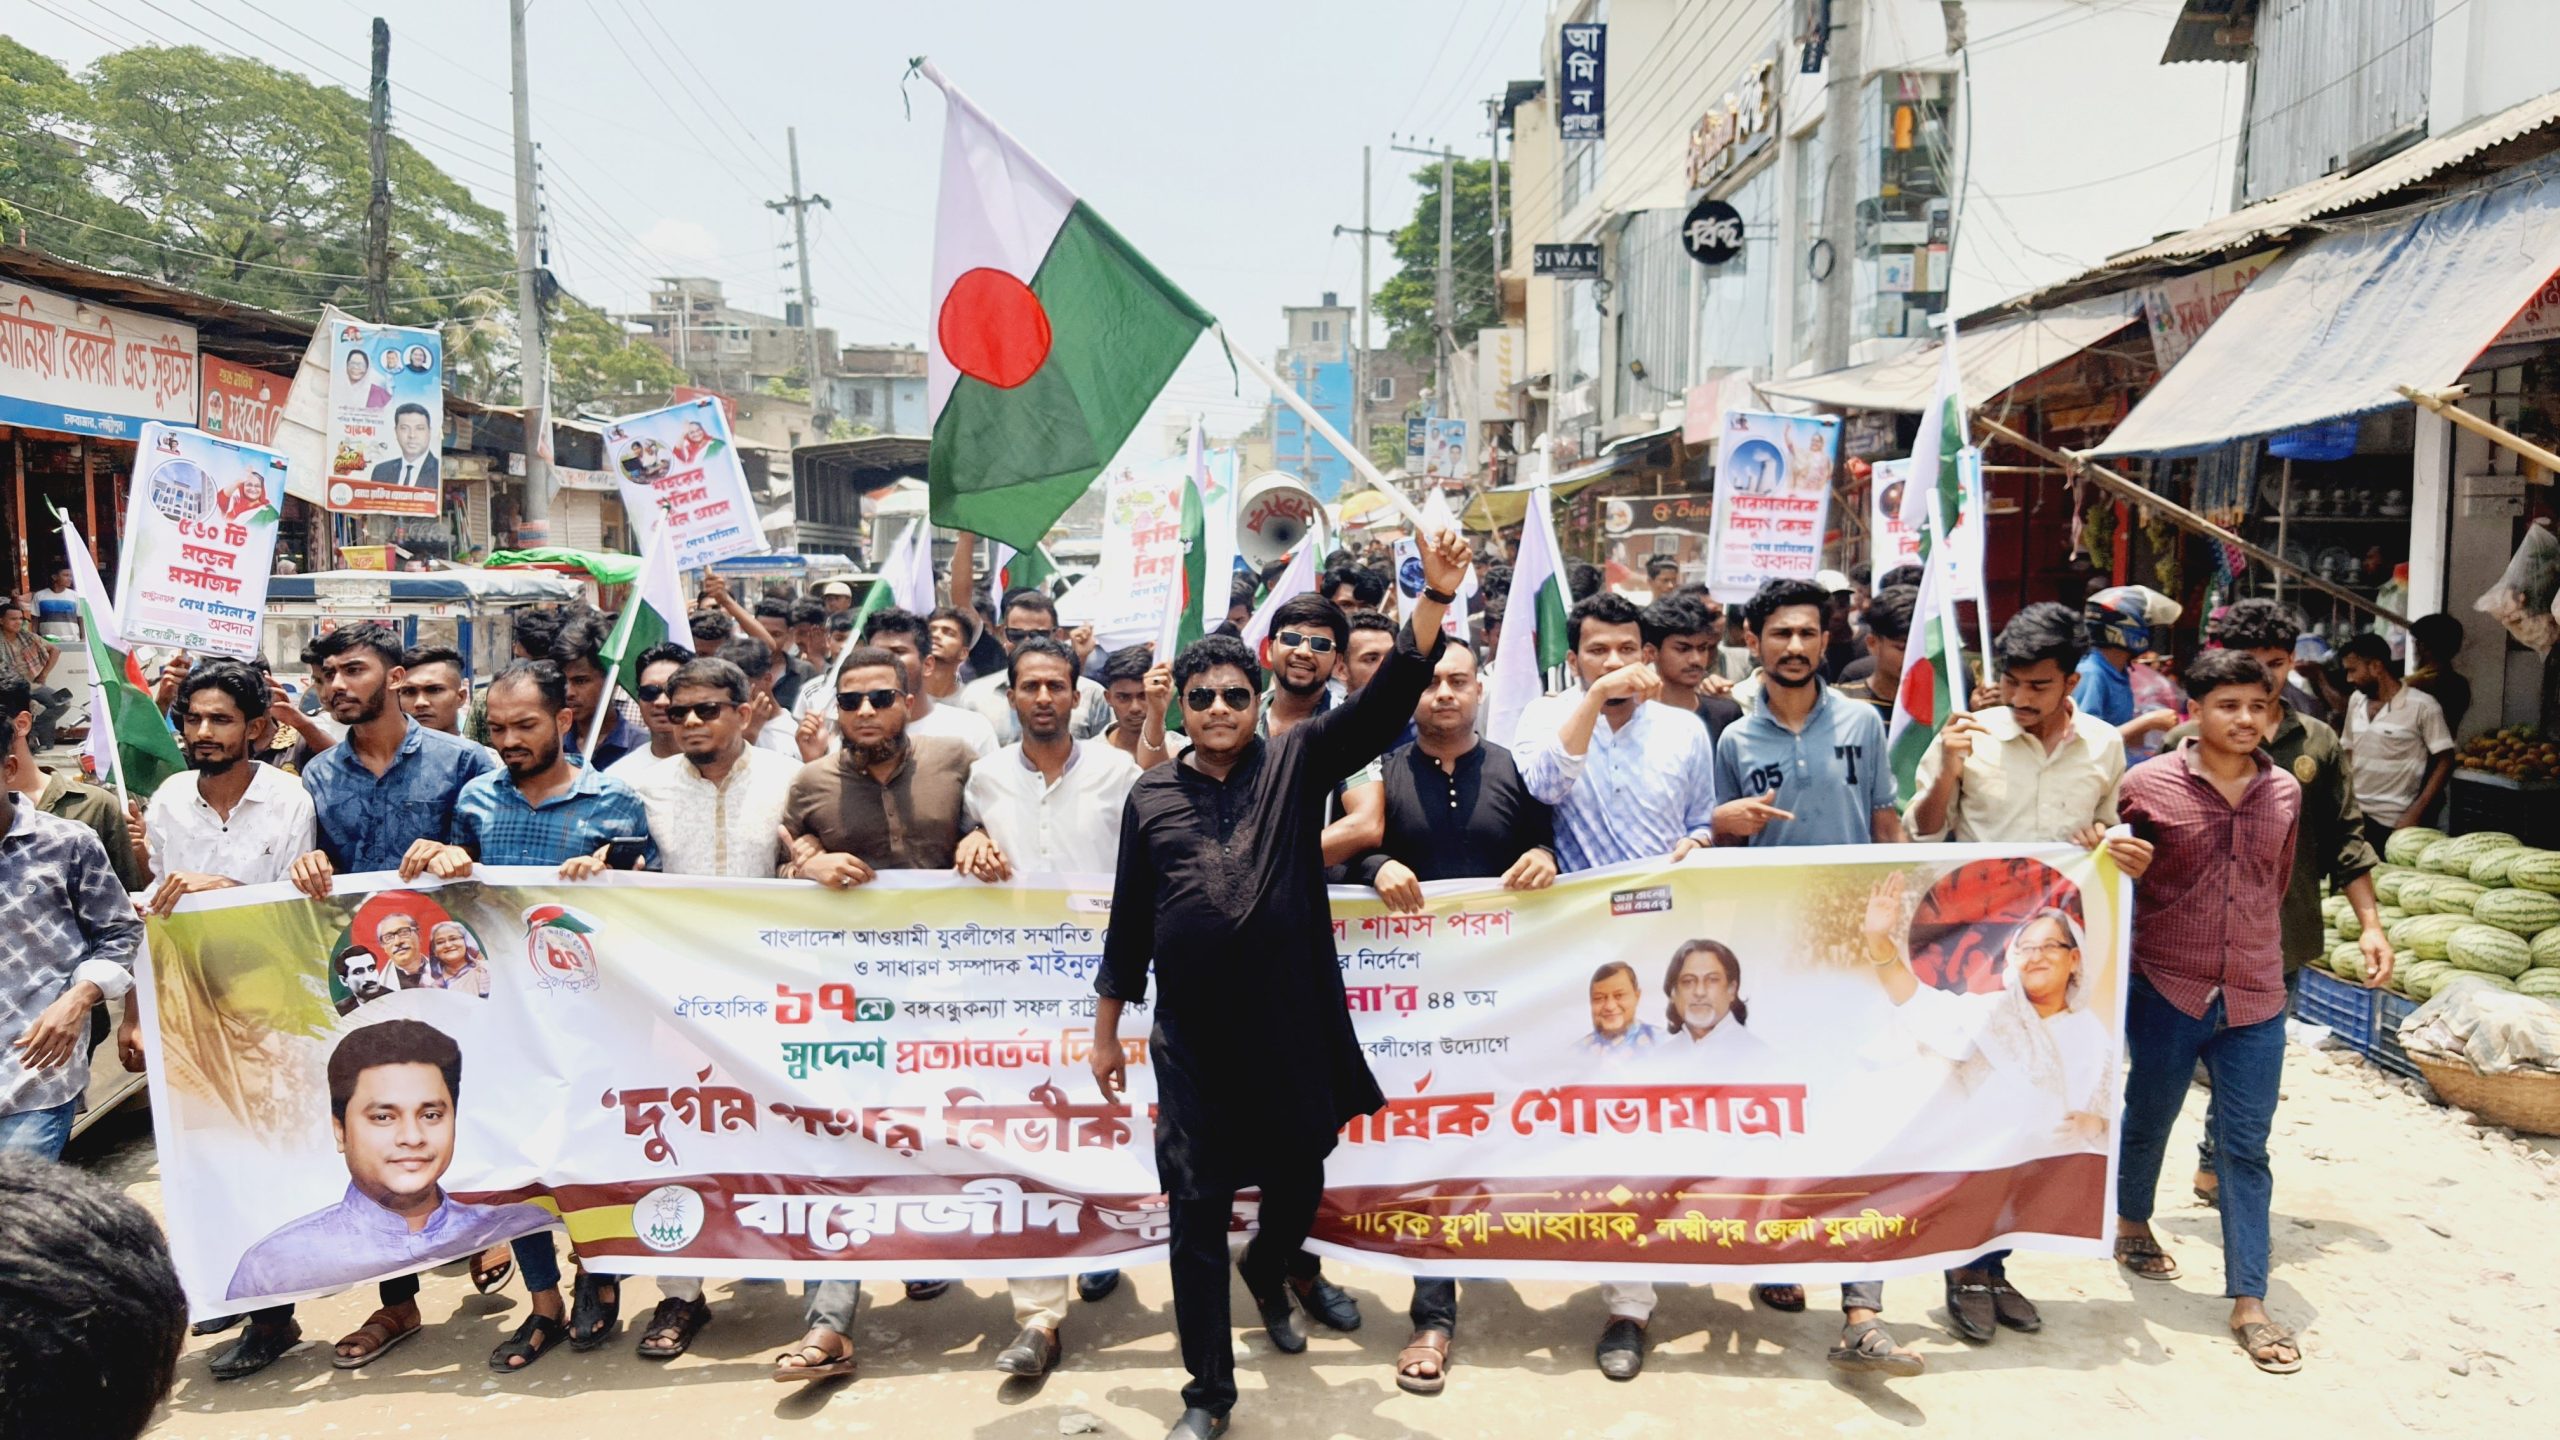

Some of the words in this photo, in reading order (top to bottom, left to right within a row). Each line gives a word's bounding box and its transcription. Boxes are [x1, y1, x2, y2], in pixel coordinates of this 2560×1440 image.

[1534, 251, 1598, 267] SIWAK
[62, 316, 117, 387] বেকারী
[223, 522, 248, 548] টি
[181, 543, 237, 571] মডেল
[1751, 553, 1813, 571] অবদান
[168, 565, 243, 597] মসজিদ
[179, 597, 205, 612] শেখ
[208, 618, 255, 638] অবদান
[1751, 762, 1783, 794] 05
[1834, 745, 1862, 785] T
[759, 928, 847, 948] বাংলাদেশ
[853, 924, 931, 947] আওয়ামী
[937, 923, 1016, 949] যুবলীগের
[1023, 922, 1095, 946] সম্মানিত
[1360, 914, 1437, 940] শামস
[1447, 909, 1514, 937] পরশ
[854, 961, 869, 976] ও
[876, 959, 941, 977] সাধারণ
[948, 958, 1023, 977] সম্পাদক
[1358, 946, 1422, 970] নির্দেশে
[674, 993, 768, 1020] ঐতিহাসিক
[903, 998, 1006, 1023] বঙ্গবন্ধুকন্যা
[1013, 999, 1063, 1019] সফল
[1427, 991, 1456, 1010] ৪৪
[1463, 989, 1498, 1007] তম
[780, 1036, 886, 1080] স্বদেশ
[895, 1028, 1053, 1074] প্রত্যাবর্তন
[1060, 1028, 1150, 1067] দিস
[1438, 1036, 1511, 1055] উদ্যোগে
[942, 1075, 1133, 1153] নির্ভীক
[1511, 1083, 1807, 1138] শোভাযাত্রা
[731, 1177, 1085, 1251] বায়েজীদ
[1754, 1215, 1817, 1245] জেলা
